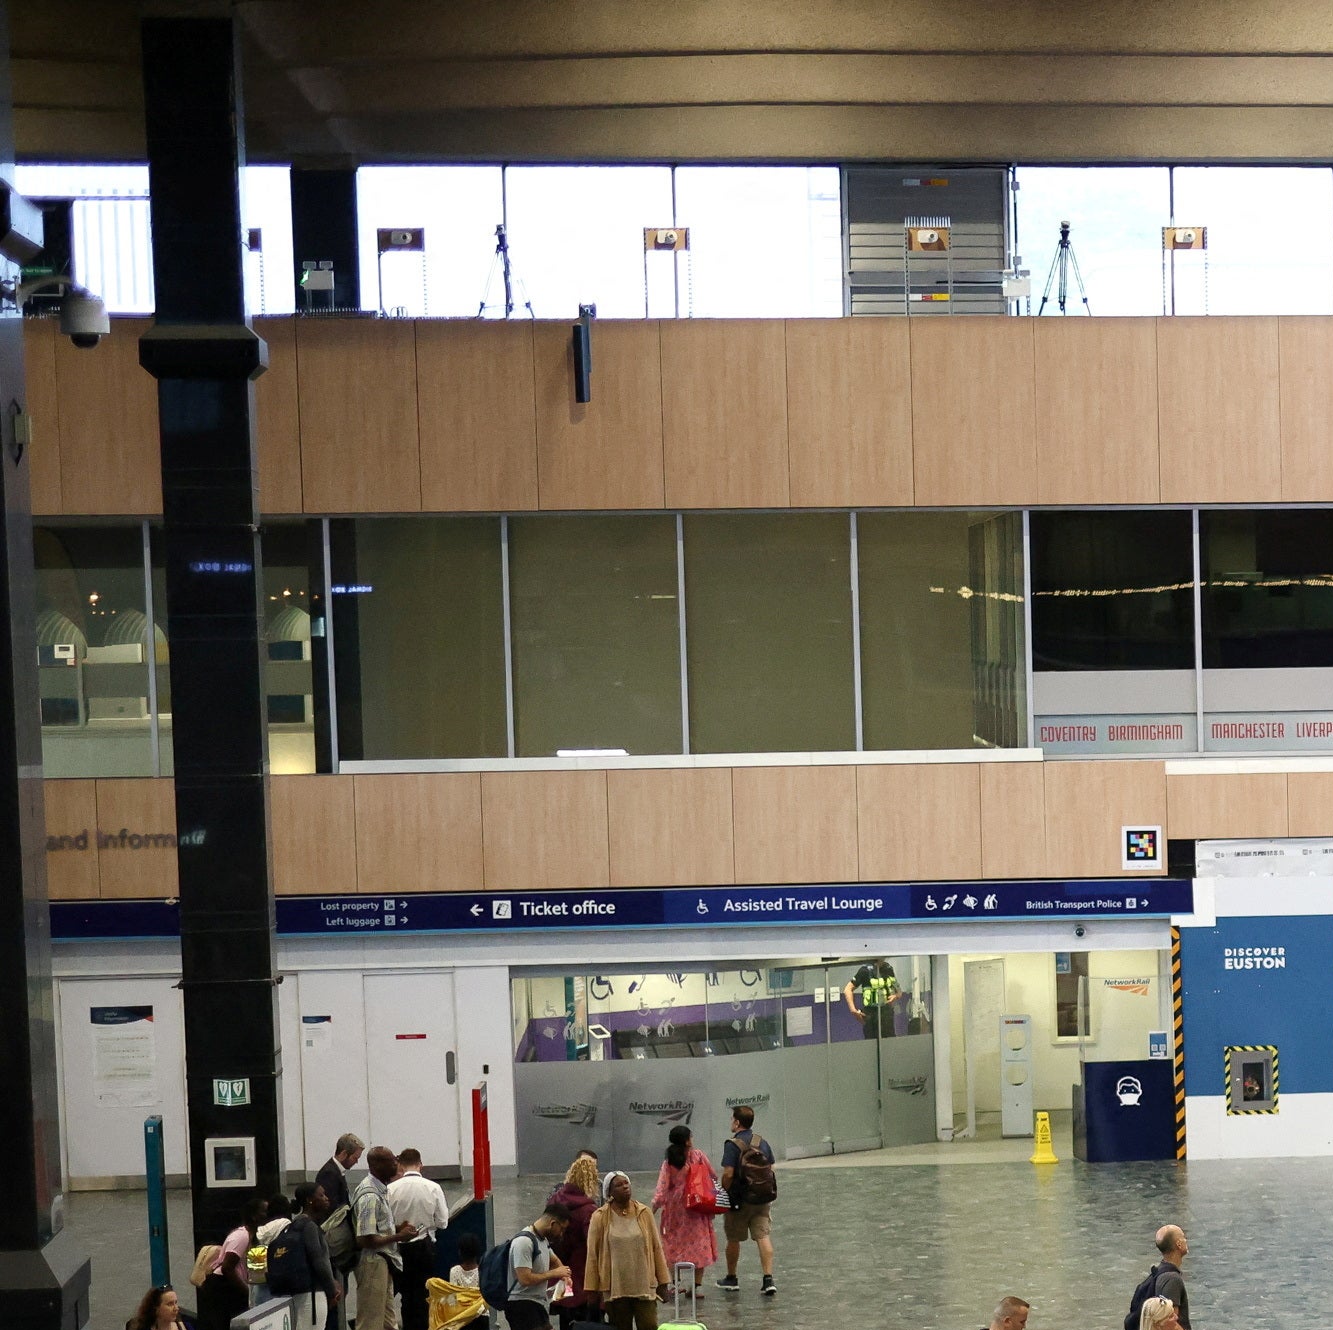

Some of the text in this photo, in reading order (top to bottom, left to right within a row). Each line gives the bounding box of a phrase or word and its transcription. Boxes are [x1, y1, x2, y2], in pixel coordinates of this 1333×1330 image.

[1040, 724, 1183, 742] COVENTRY BIRMINGHAM
[1211, 722, 1285, 740] MANCHESTER
[321, 901, 380, 912] Lost property
[520, 900, 616, 916] Ticket office
[724, 896, 883, 912] Assisted Travel Lounge
[1026, 898, 1122, 911] British Transport Police
[326, 916, 380, 928] Left luggage
[1224, 947, 1286, 957] DISCOVER
[1224, 957, 1286, 970] EUSTON
